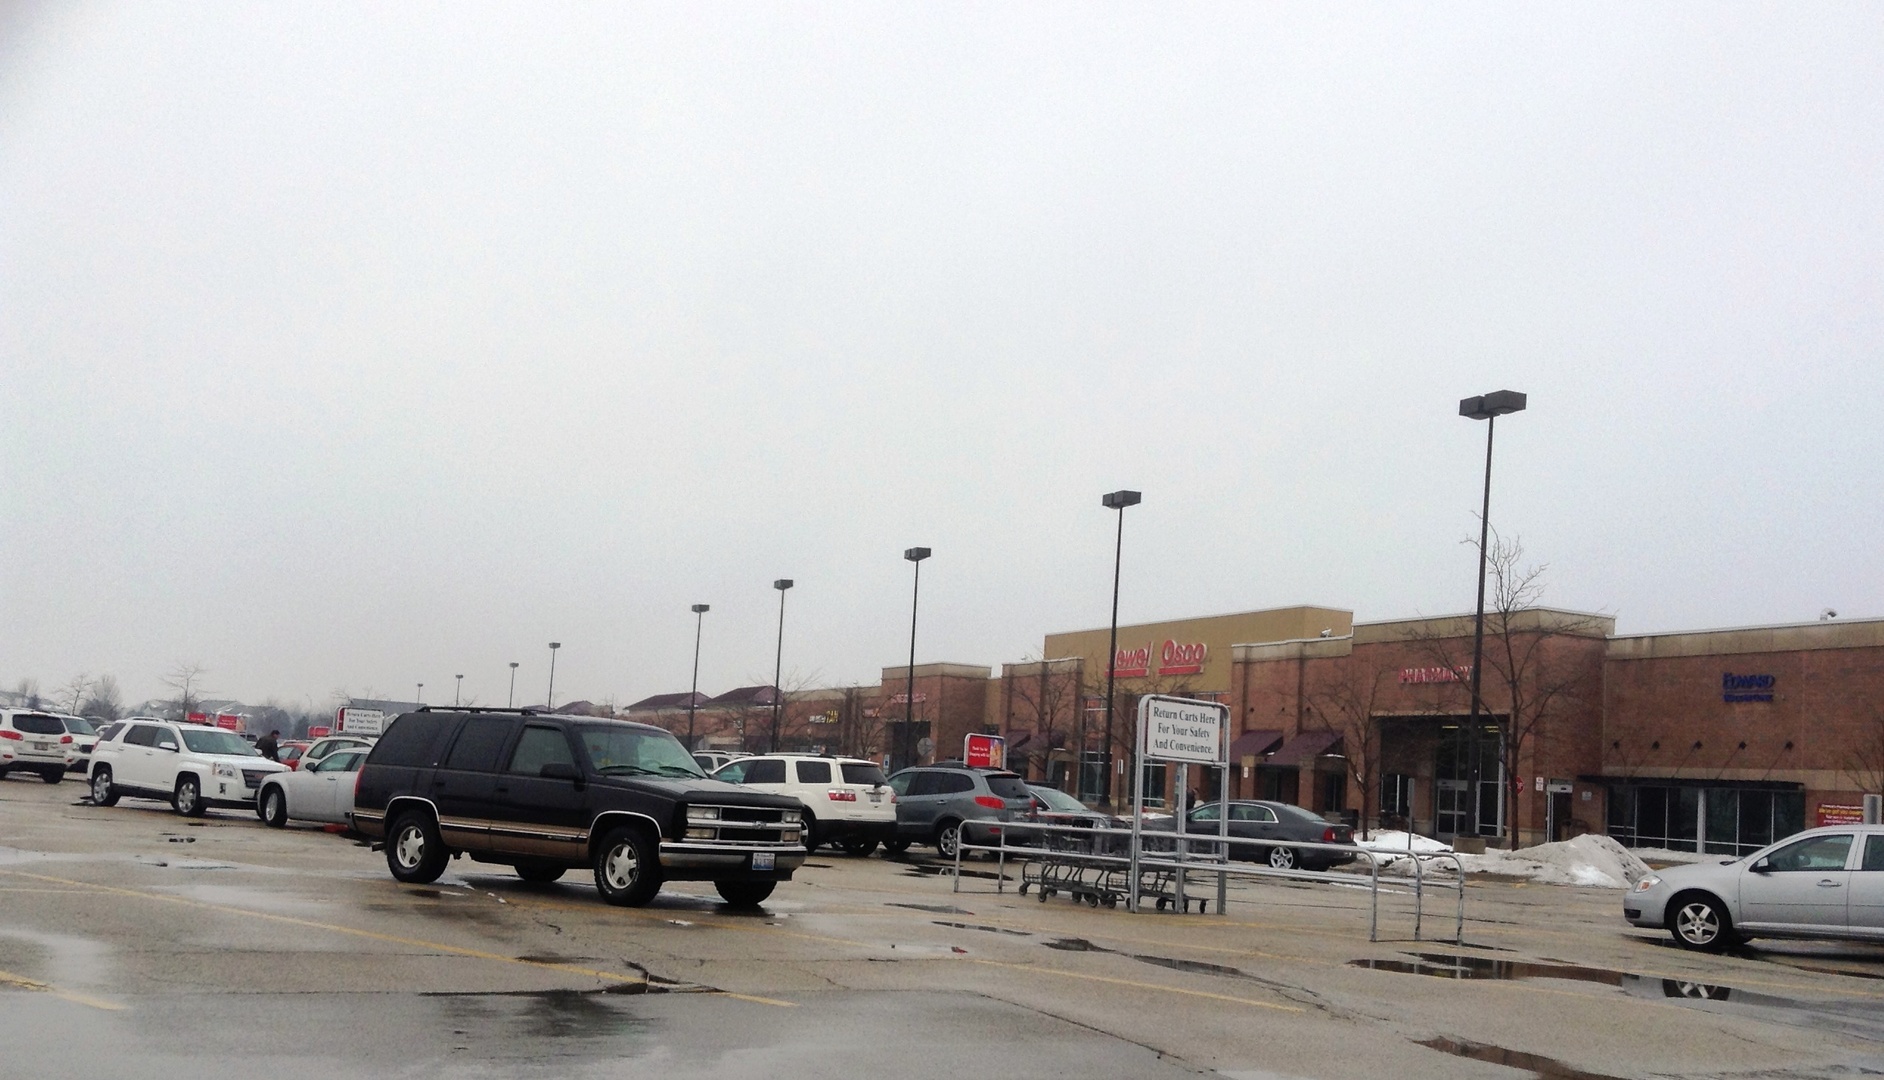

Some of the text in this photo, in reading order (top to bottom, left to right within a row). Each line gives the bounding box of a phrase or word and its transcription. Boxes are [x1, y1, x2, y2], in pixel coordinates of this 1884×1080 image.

[1162, 640, 1207, 666] Osco
[1153, 706, 1216, 724] Return Carts Here
[1158, 723, 1210, 740] For Your Safety
[1153, 739, 1214, 754] And Convenience.
